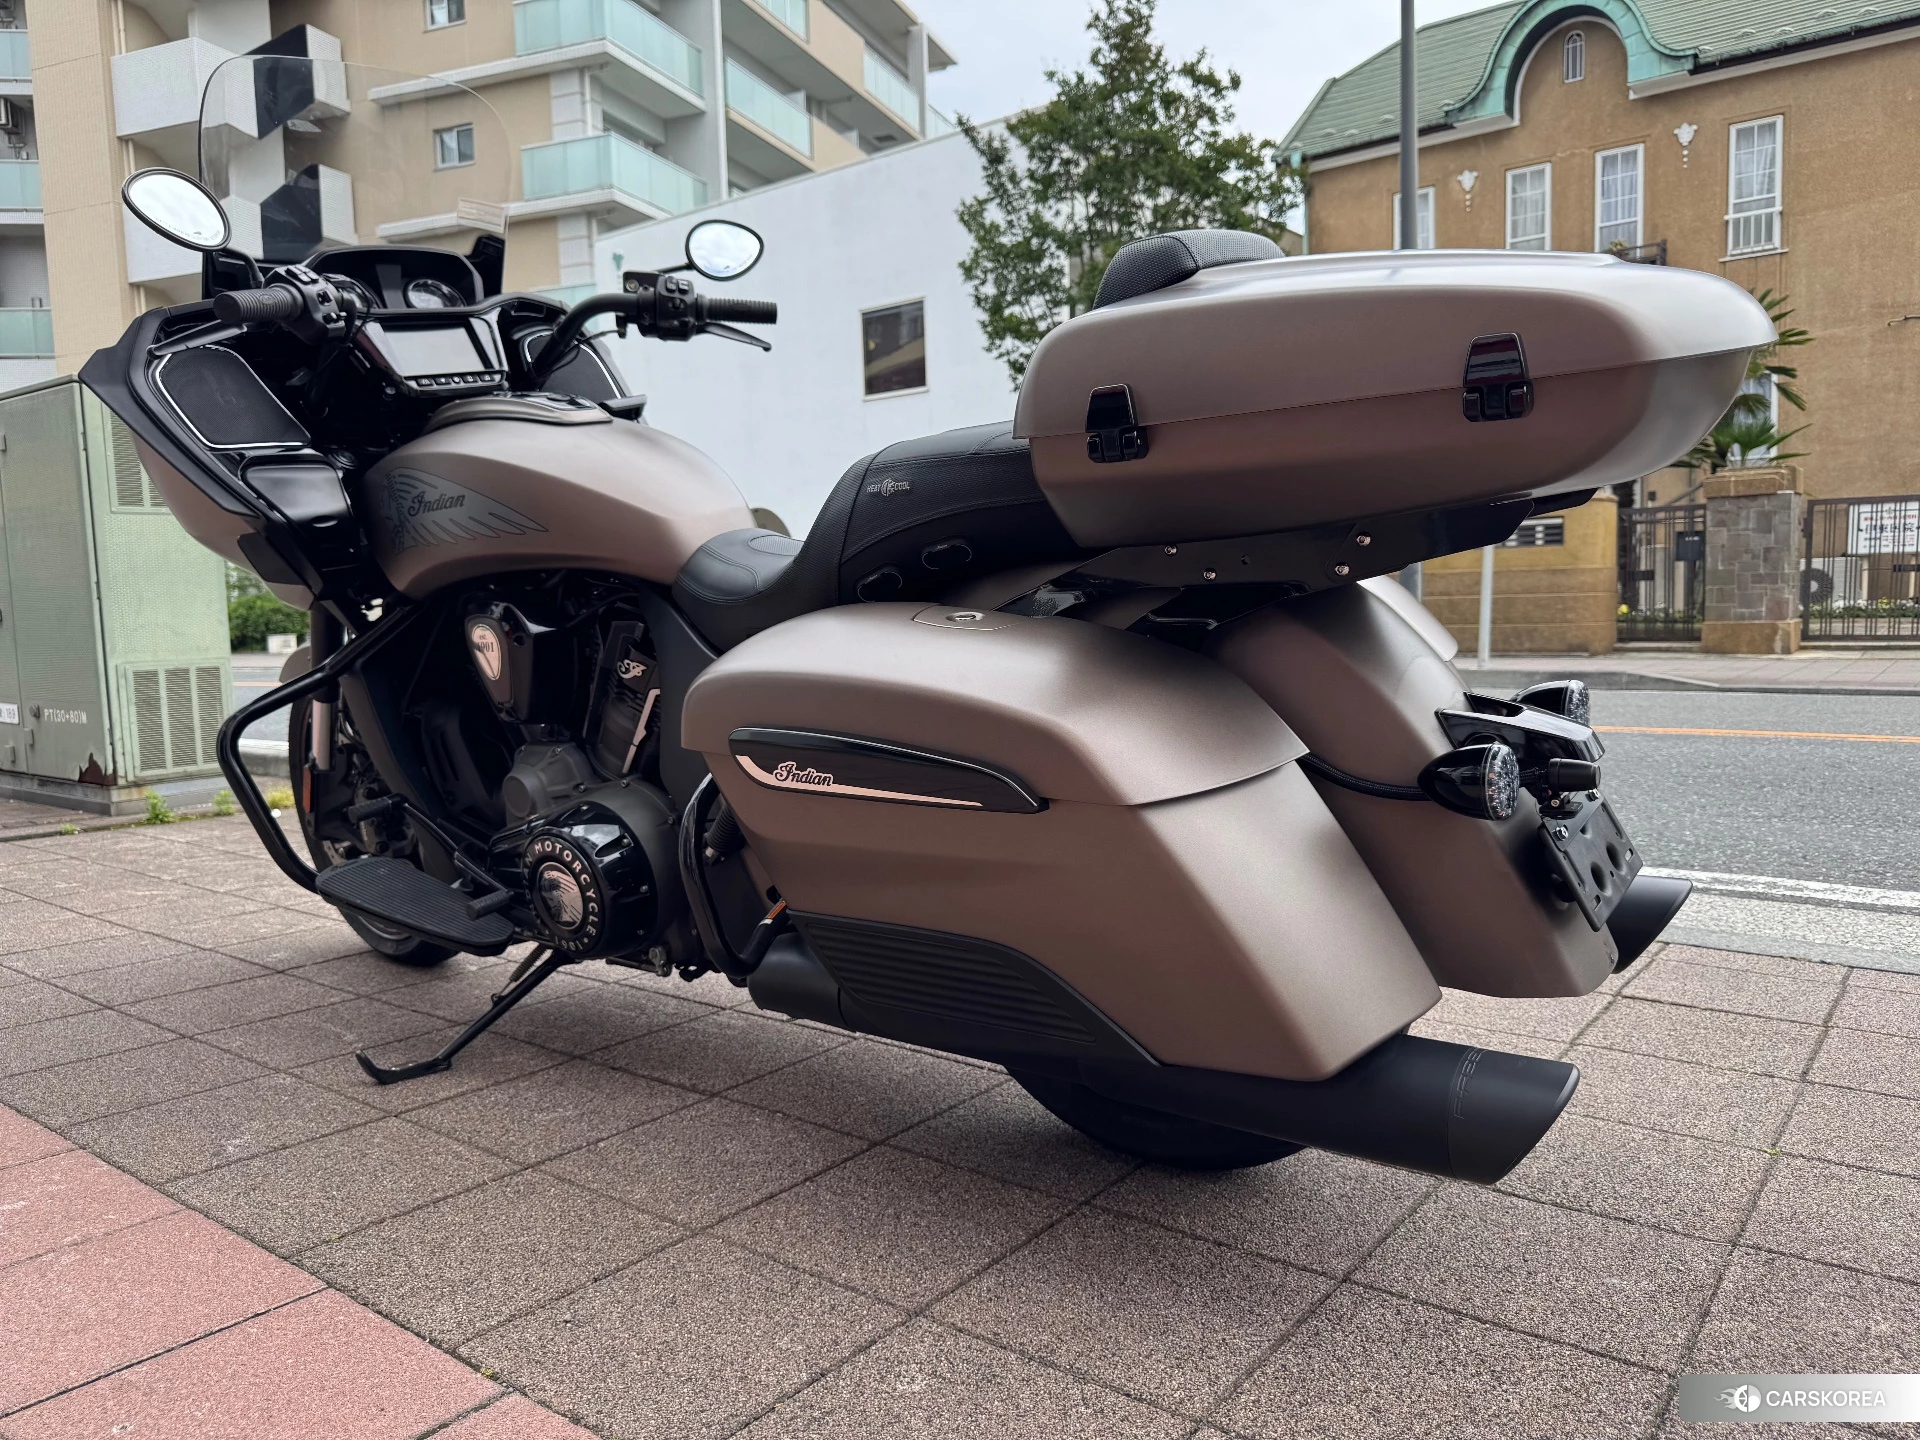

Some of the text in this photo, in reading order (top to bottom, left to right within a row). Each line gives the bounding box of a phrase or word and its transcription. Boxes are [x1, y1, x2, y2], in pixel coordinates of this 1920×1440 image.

[408, 491, 466, 517] Indian
[774, 762, 833, 787] Indian
[534, 840, 599, 937] MOTORCYCLE
